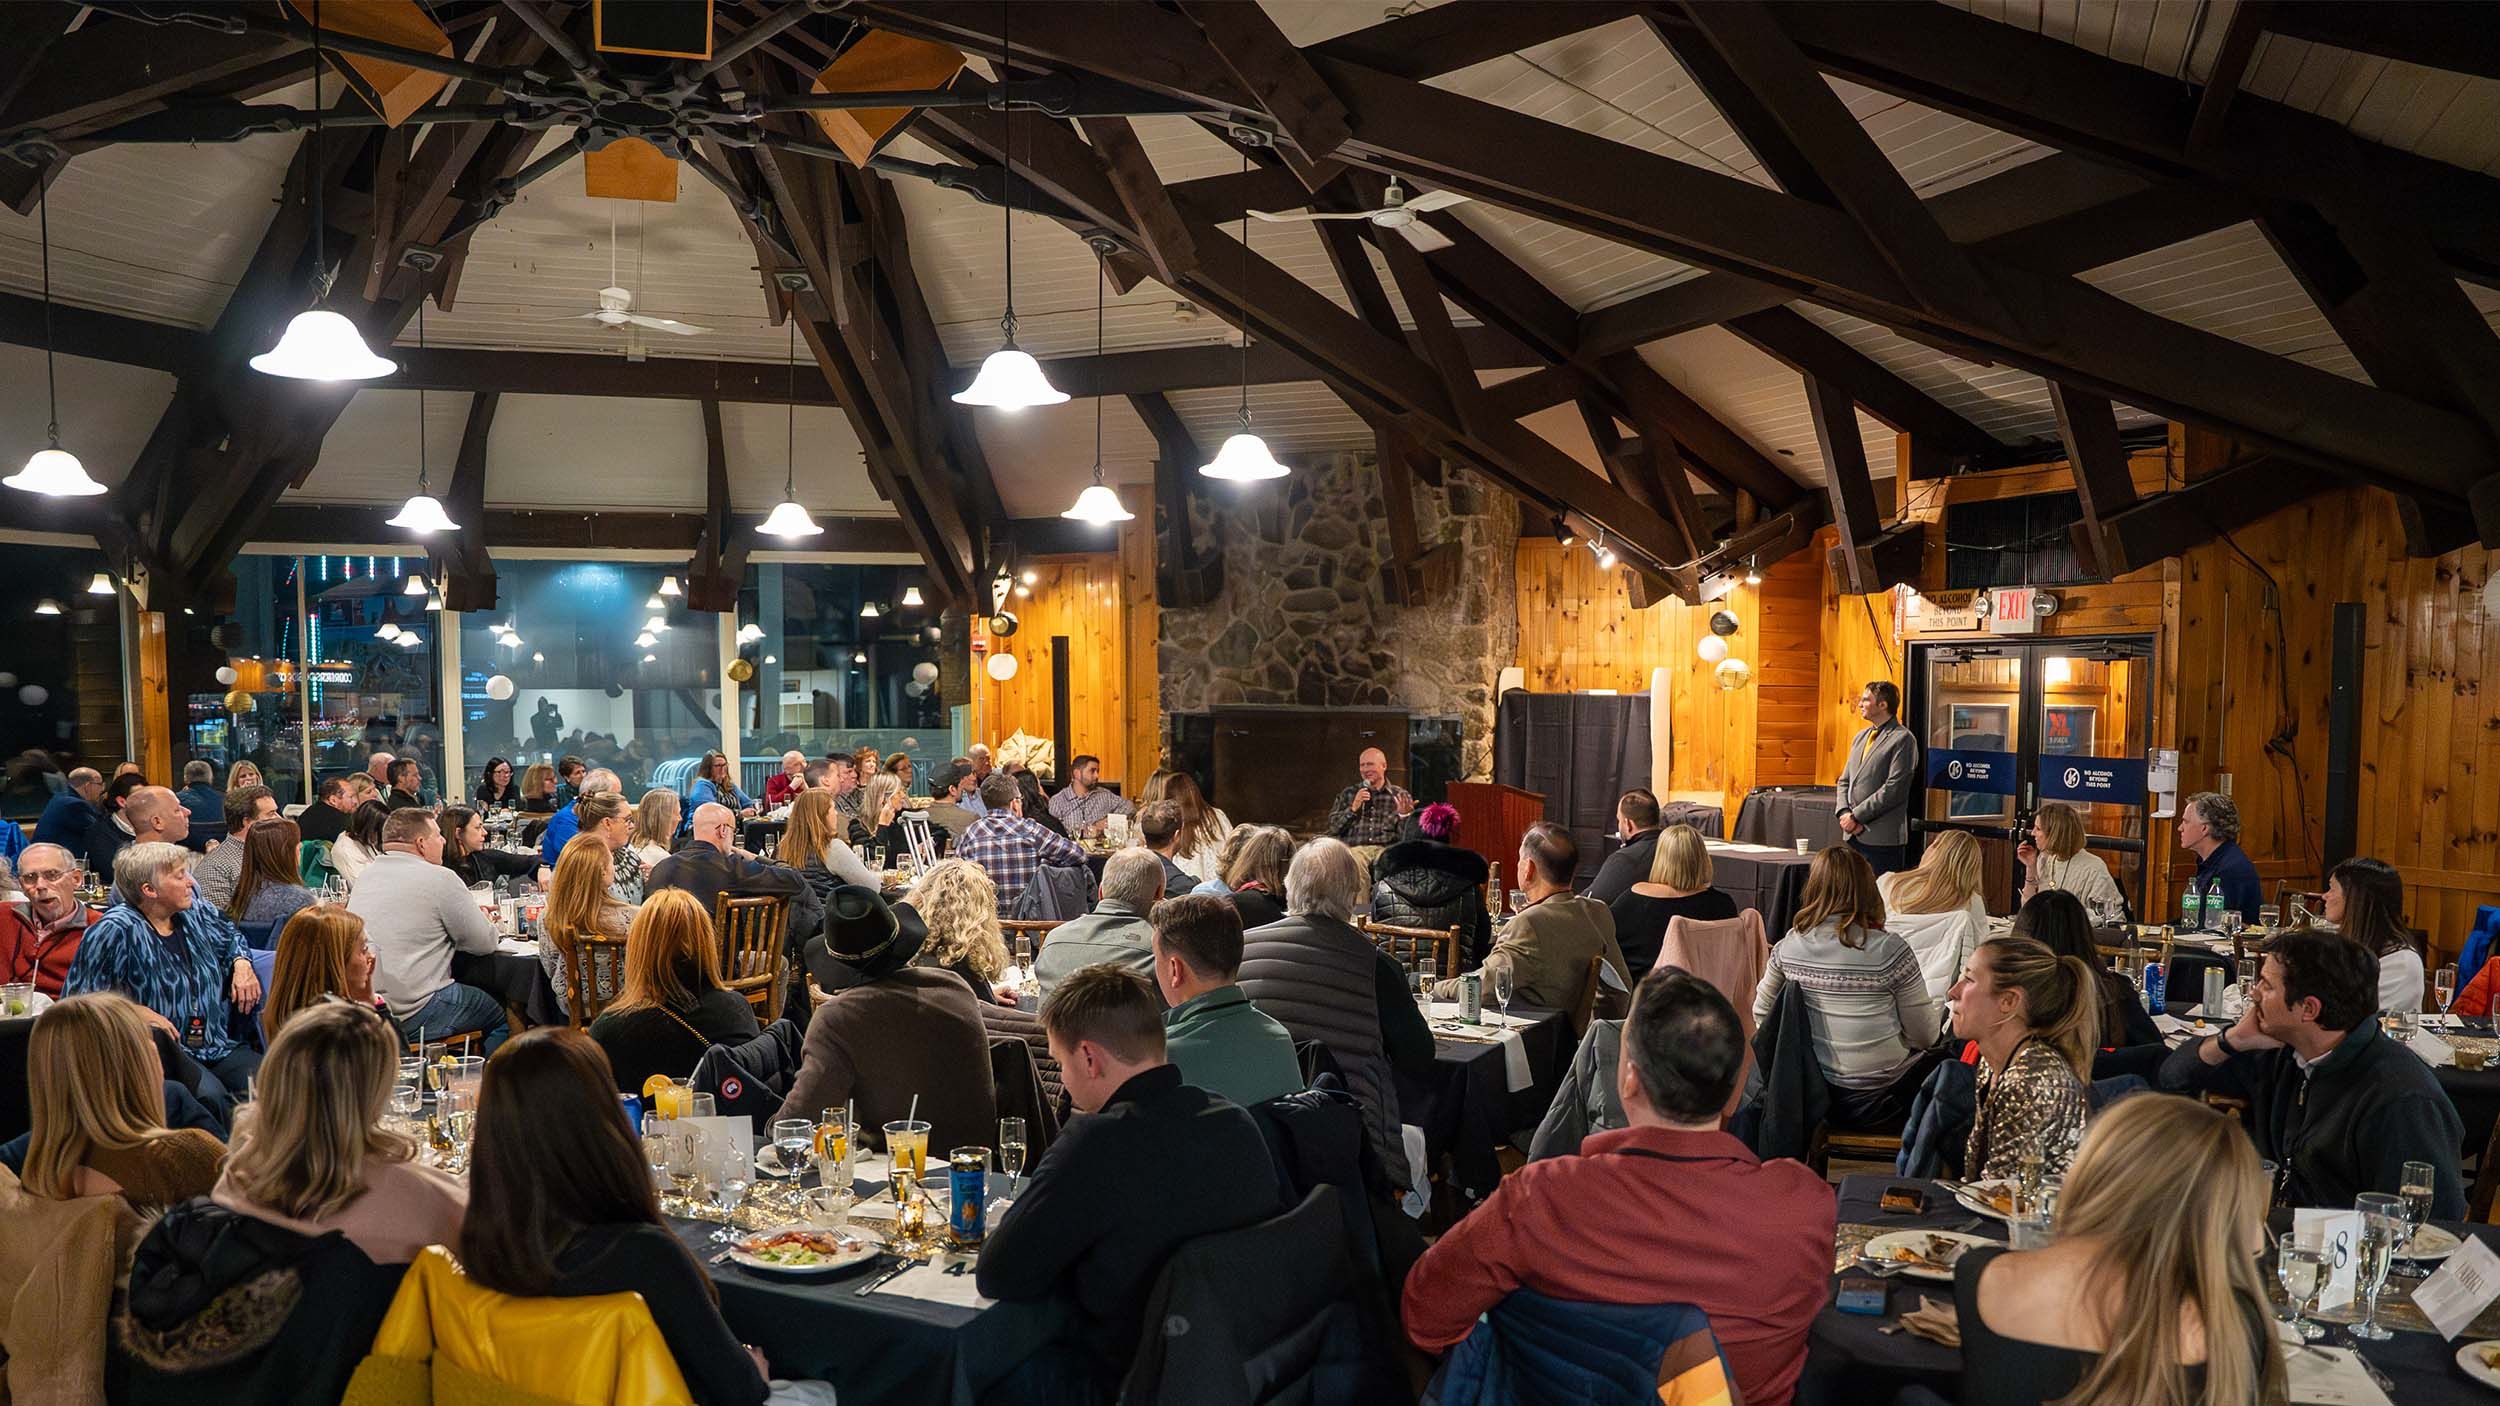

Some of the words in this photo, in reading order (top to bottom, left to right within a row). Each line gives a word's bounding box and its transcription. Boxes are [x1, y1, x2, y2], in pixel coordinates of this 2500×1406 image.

[1940, 591, 1972, 604] ALCOHOL
[1934, 605, 1962, 616] BEYOND
[1998, 591, 2030, 620] EXIT
[1929, 618, 1943, 628] THIS
[1946, 616, 1968, 627] POINT
[2333, 1230, 2348, 1269] 8
